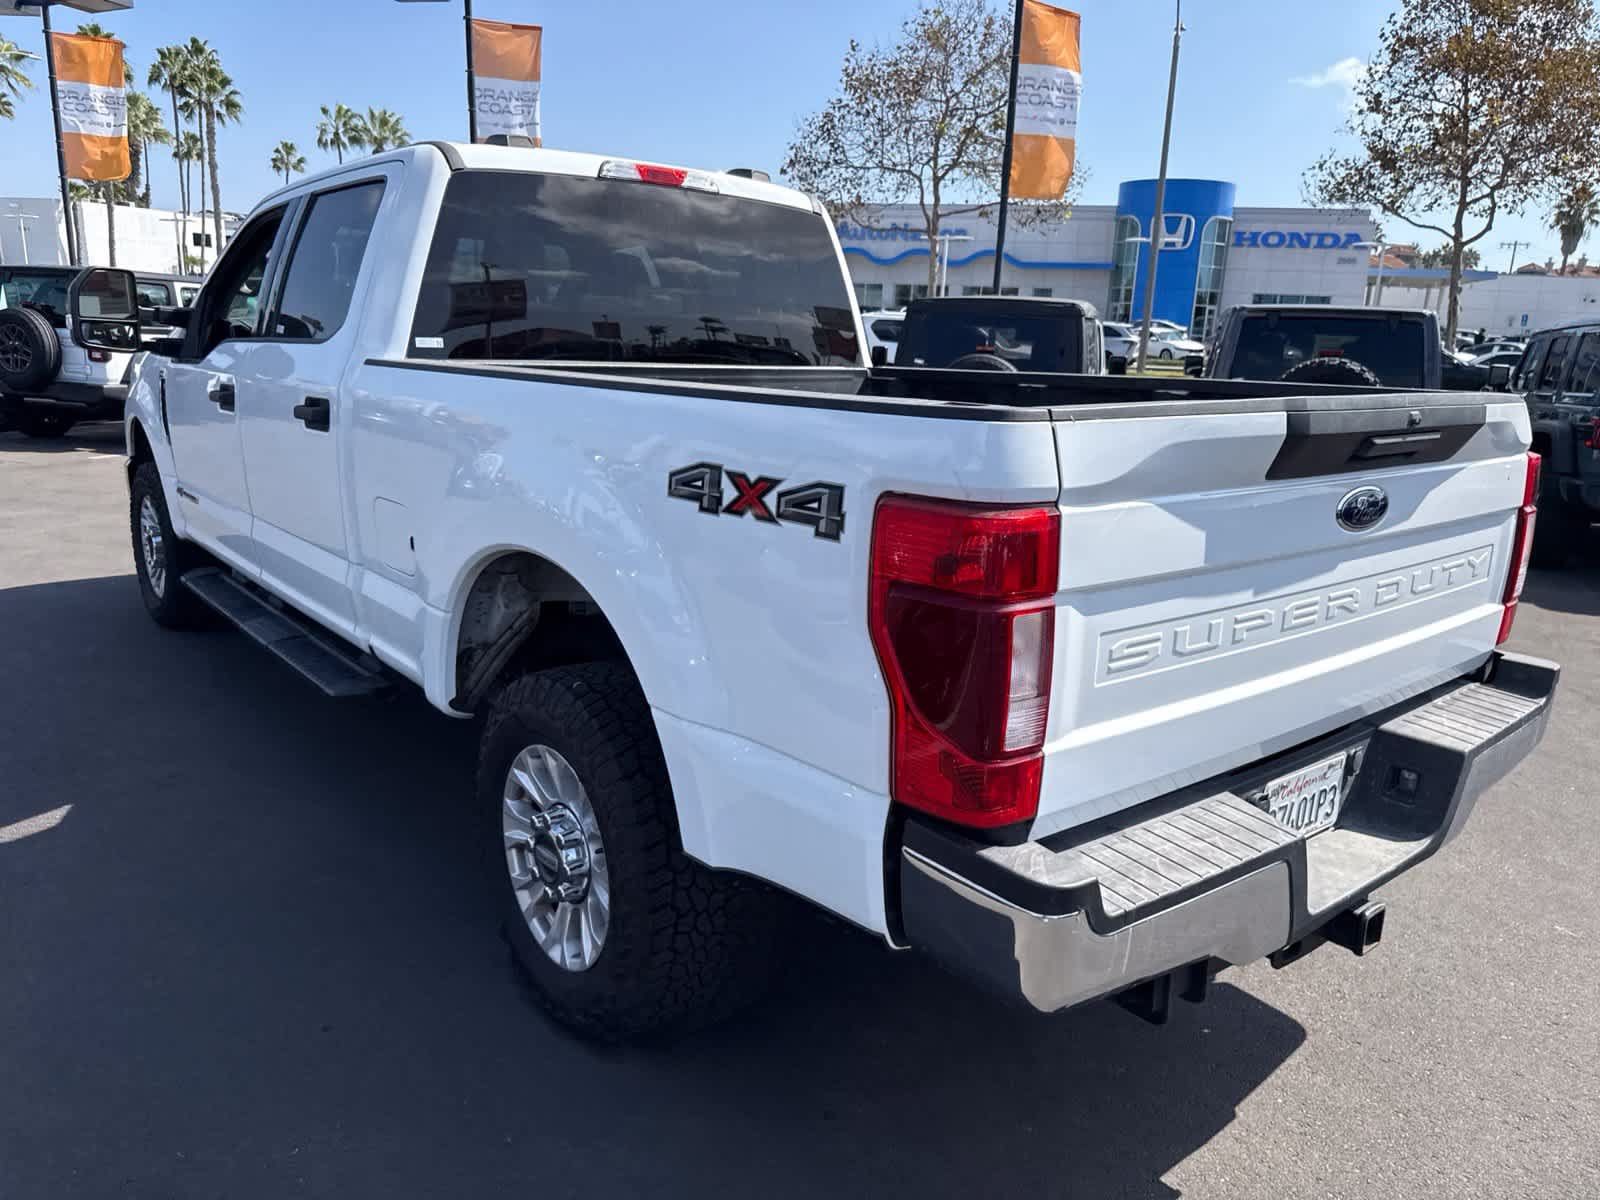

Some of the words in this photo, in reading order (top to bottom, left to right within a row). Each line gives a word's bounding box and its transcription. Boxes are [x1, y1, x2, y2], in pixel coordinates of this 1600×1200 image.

[62, 101, 121, 116] COAST
[478, 101, 534, 116] COAST
[1017, 91, 1078, 109] COAST
[1232, 231, 1369, 249] HONDA
[1106, 588, 1360, 675] SUPER
[1375, 551, 1490, 607] DUTY
